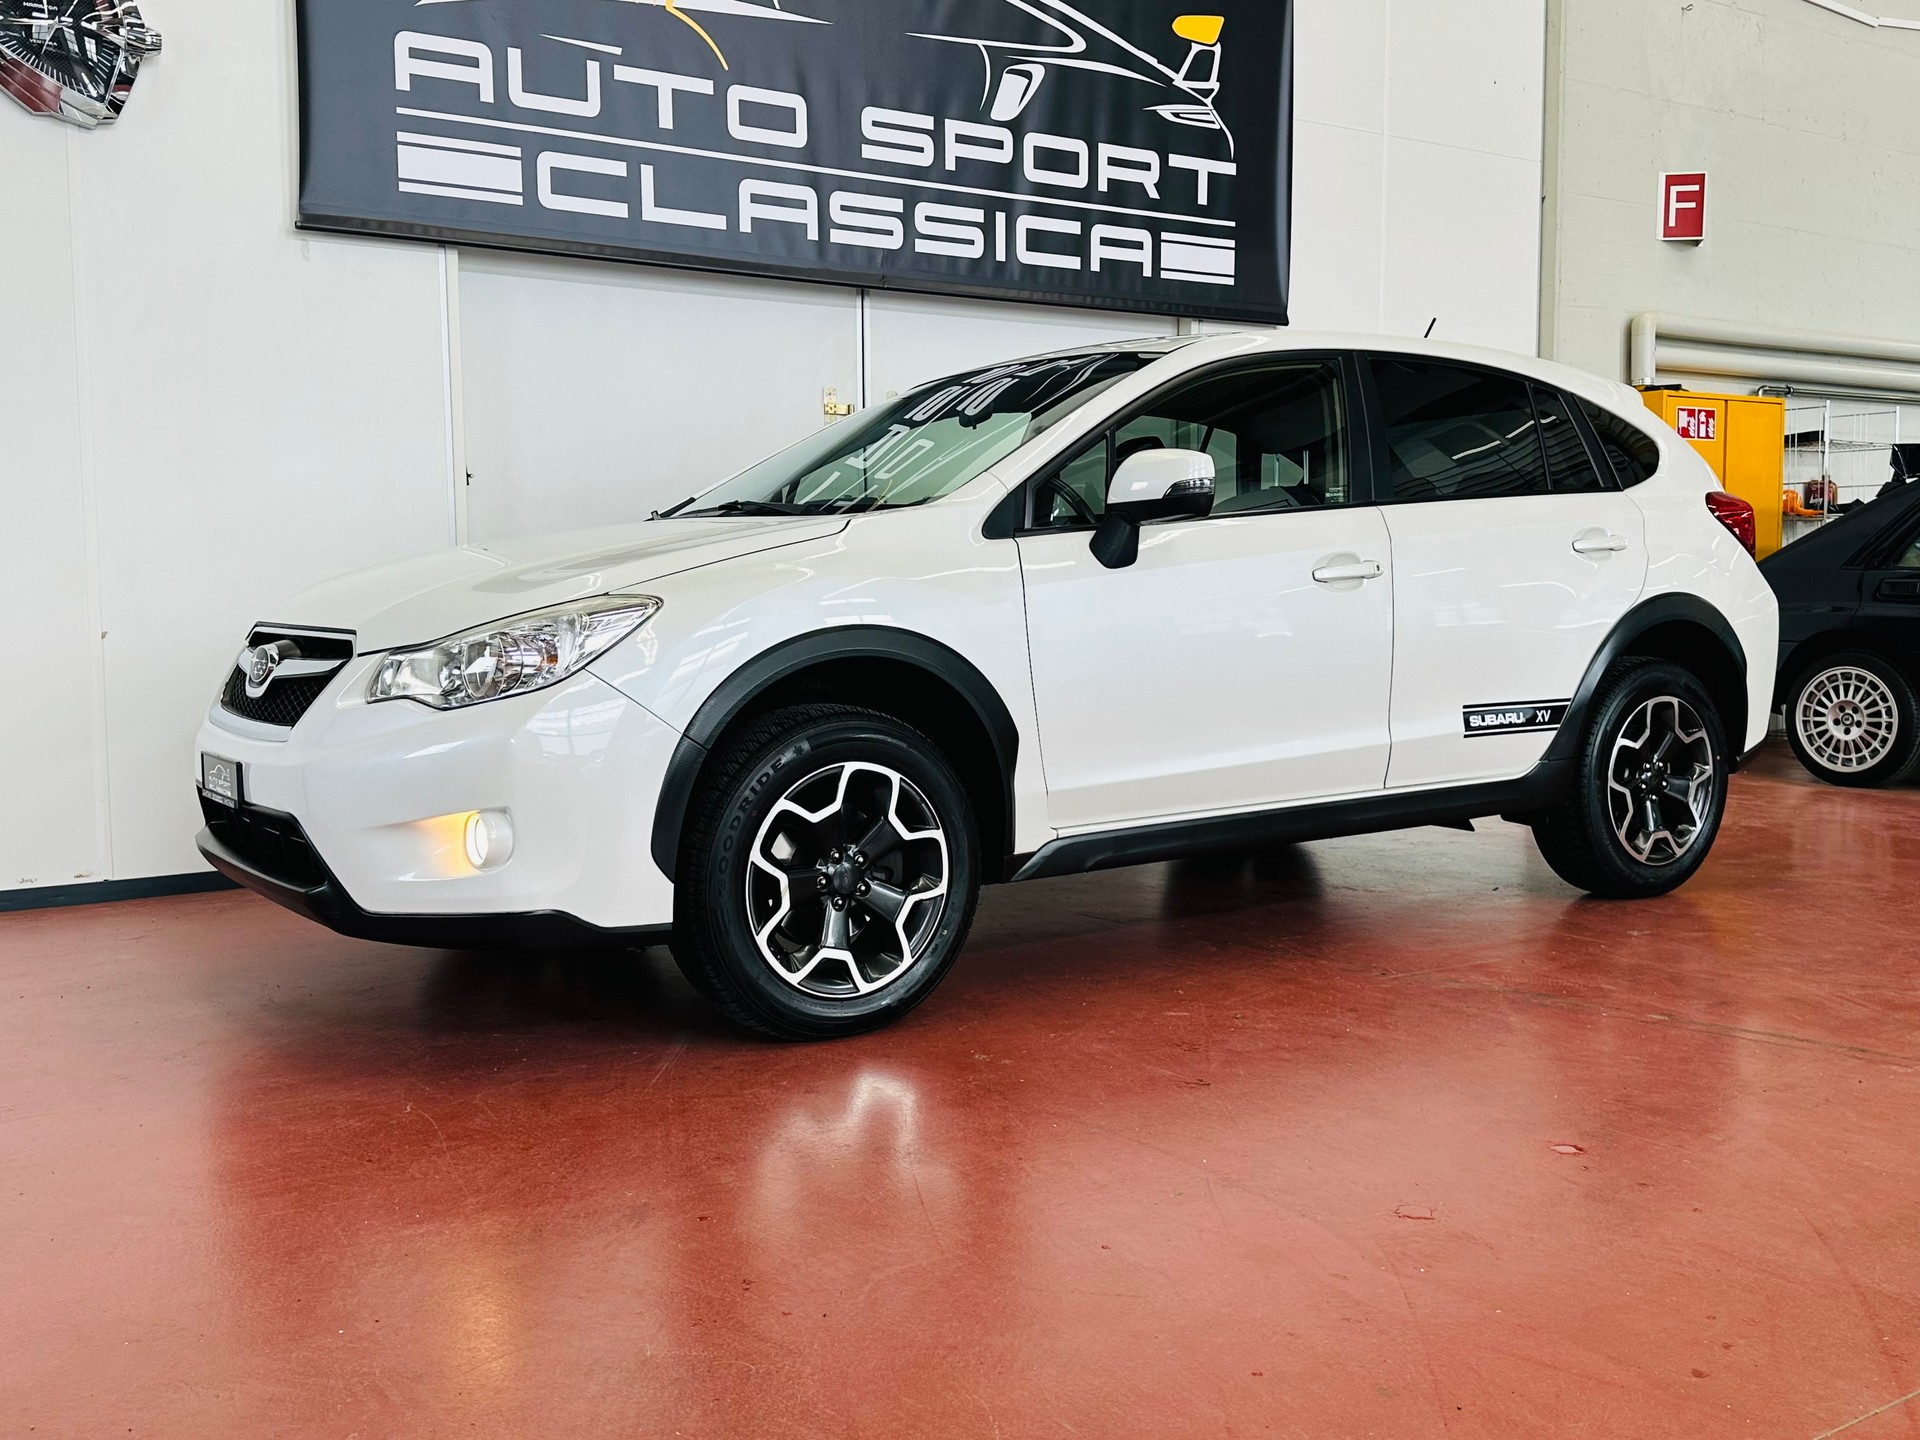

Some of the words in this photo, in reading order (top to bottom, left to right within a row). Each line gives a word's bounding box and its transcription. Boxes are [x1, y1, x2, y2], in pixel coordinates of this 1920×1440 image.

[394, 31, 808, 148] AUTO
[861, 107, 1236, 206] SPORT
[536, 151, 1153, 278] CLASSICA
[1669, 184, 1700, 227] F
[1469, 712, 1523, 727] SUBARU
[1535, 709, 1551, 723] XV
[717, 756, 785, 897] GOODRIDE
